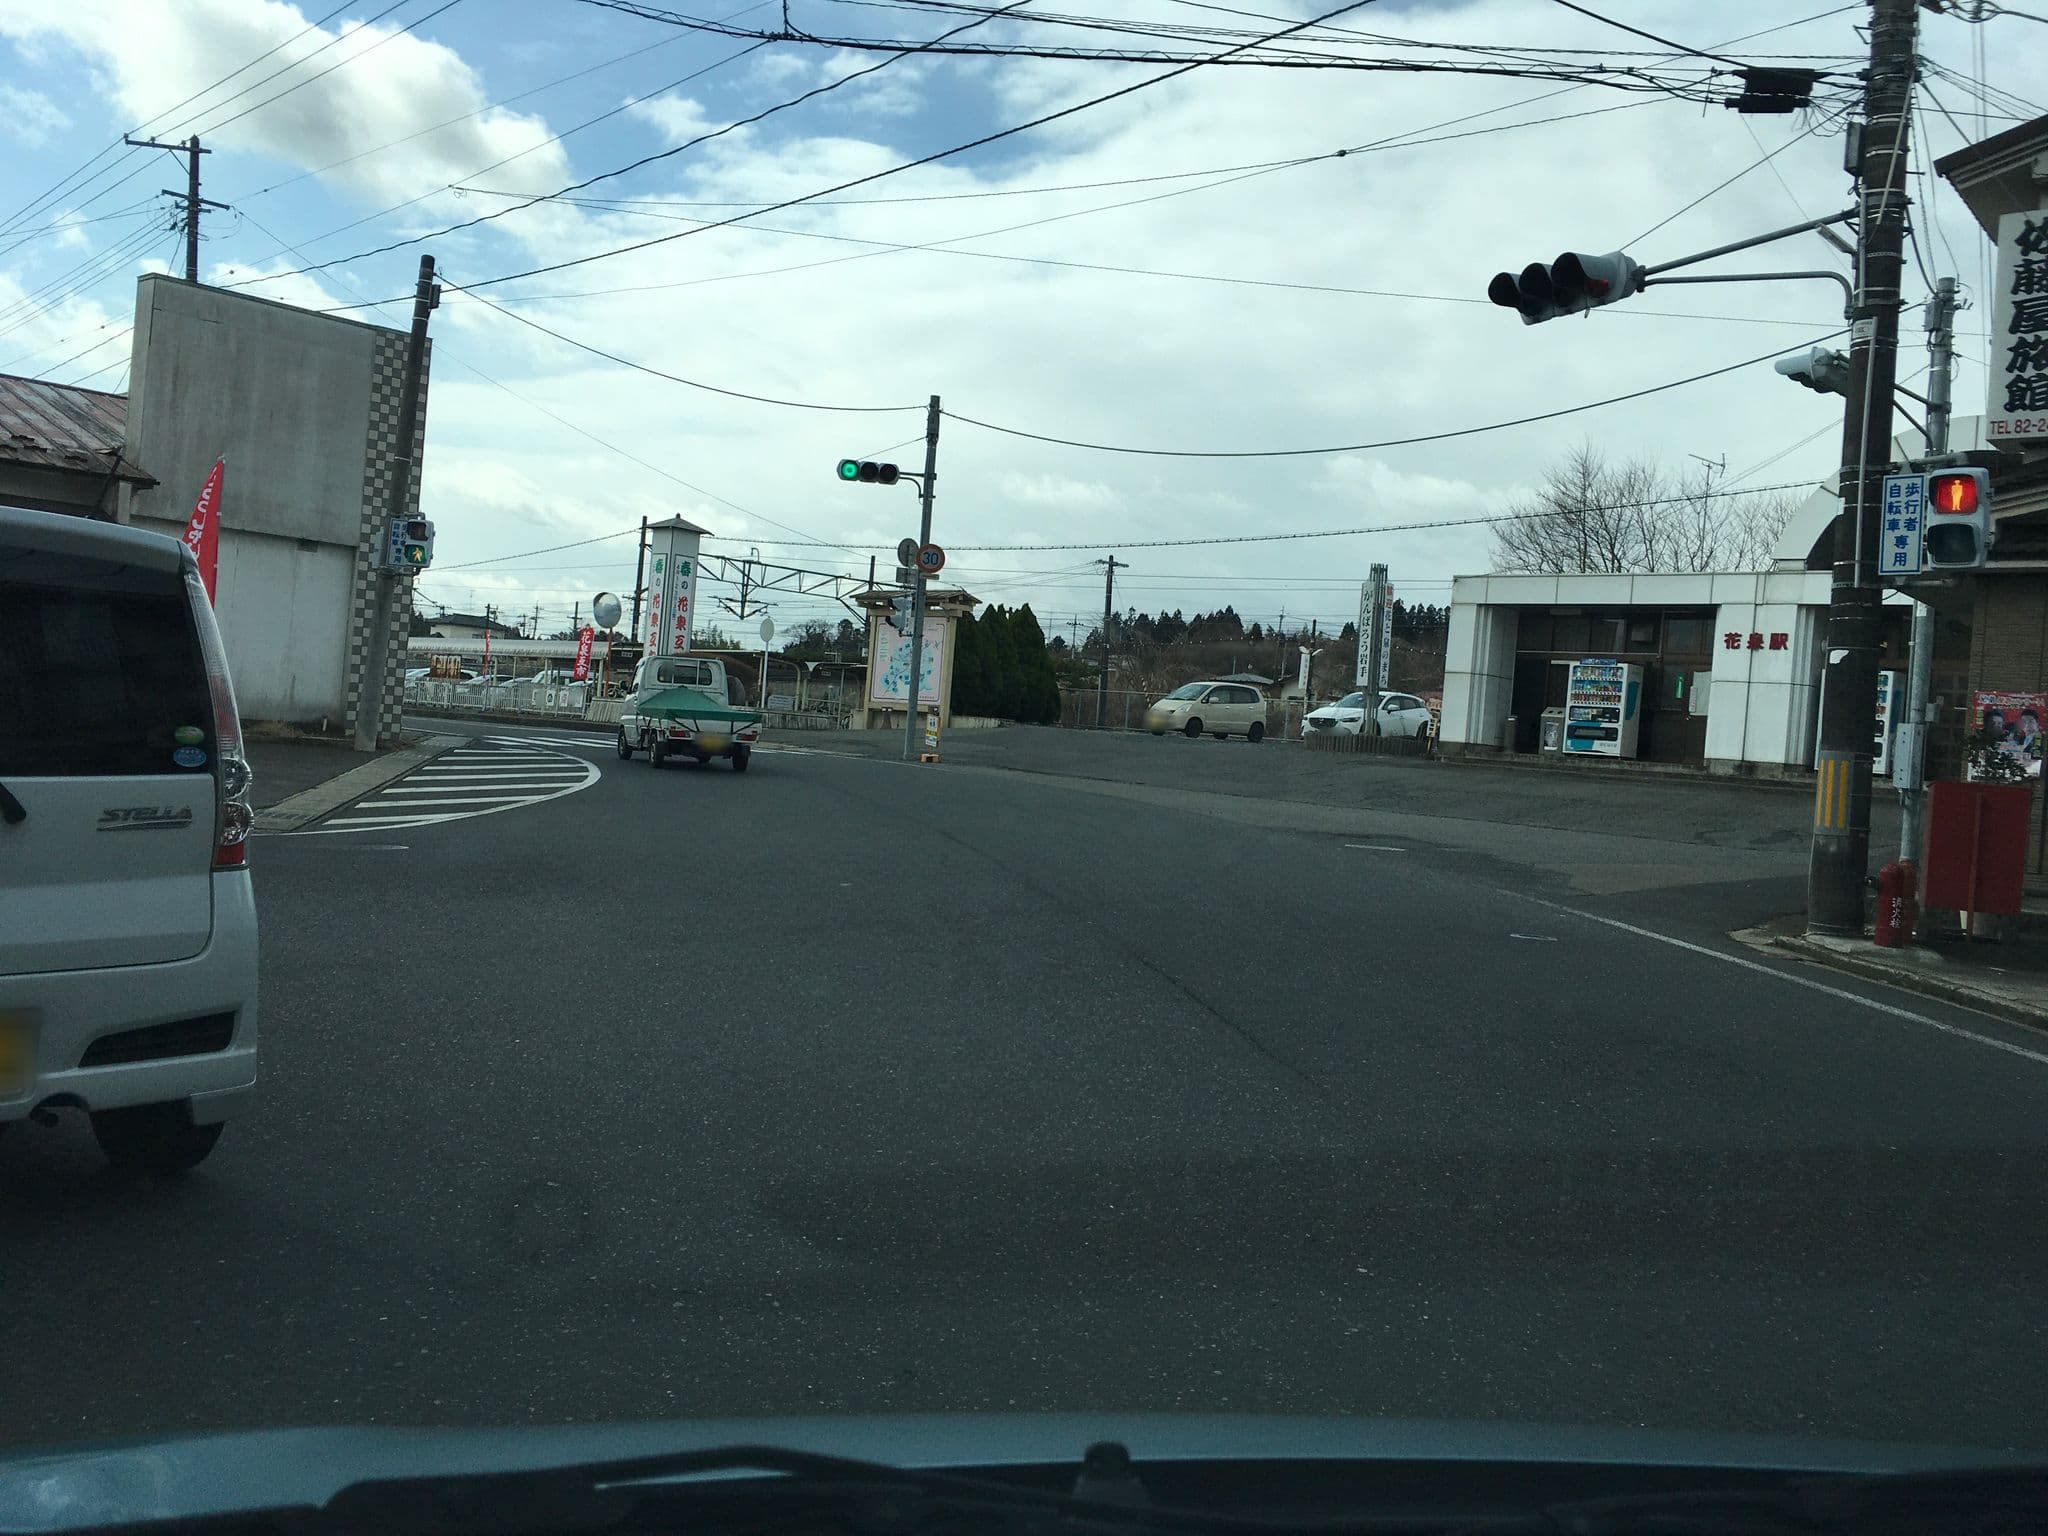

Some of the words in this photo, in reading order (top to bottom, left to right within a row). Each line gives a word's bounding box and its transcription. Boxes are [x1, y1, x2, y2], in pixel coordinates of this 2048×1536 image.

[1990, 420, 2012, 434] TEL
[2014, 418, 2048, 433] 82-2
[1886, 484, 1901, 533] 自転車
[1904, 482, 1920, 532] 歩行者
[923, 552, 939, 566] 30
[1893, 534, 1909, 567] 専用
[1360, 590, 1374, 678] がんばろう岩手
[1724, 632, 1788, 652] 花泉駅
[98, 806, 192, 822] STELLA
